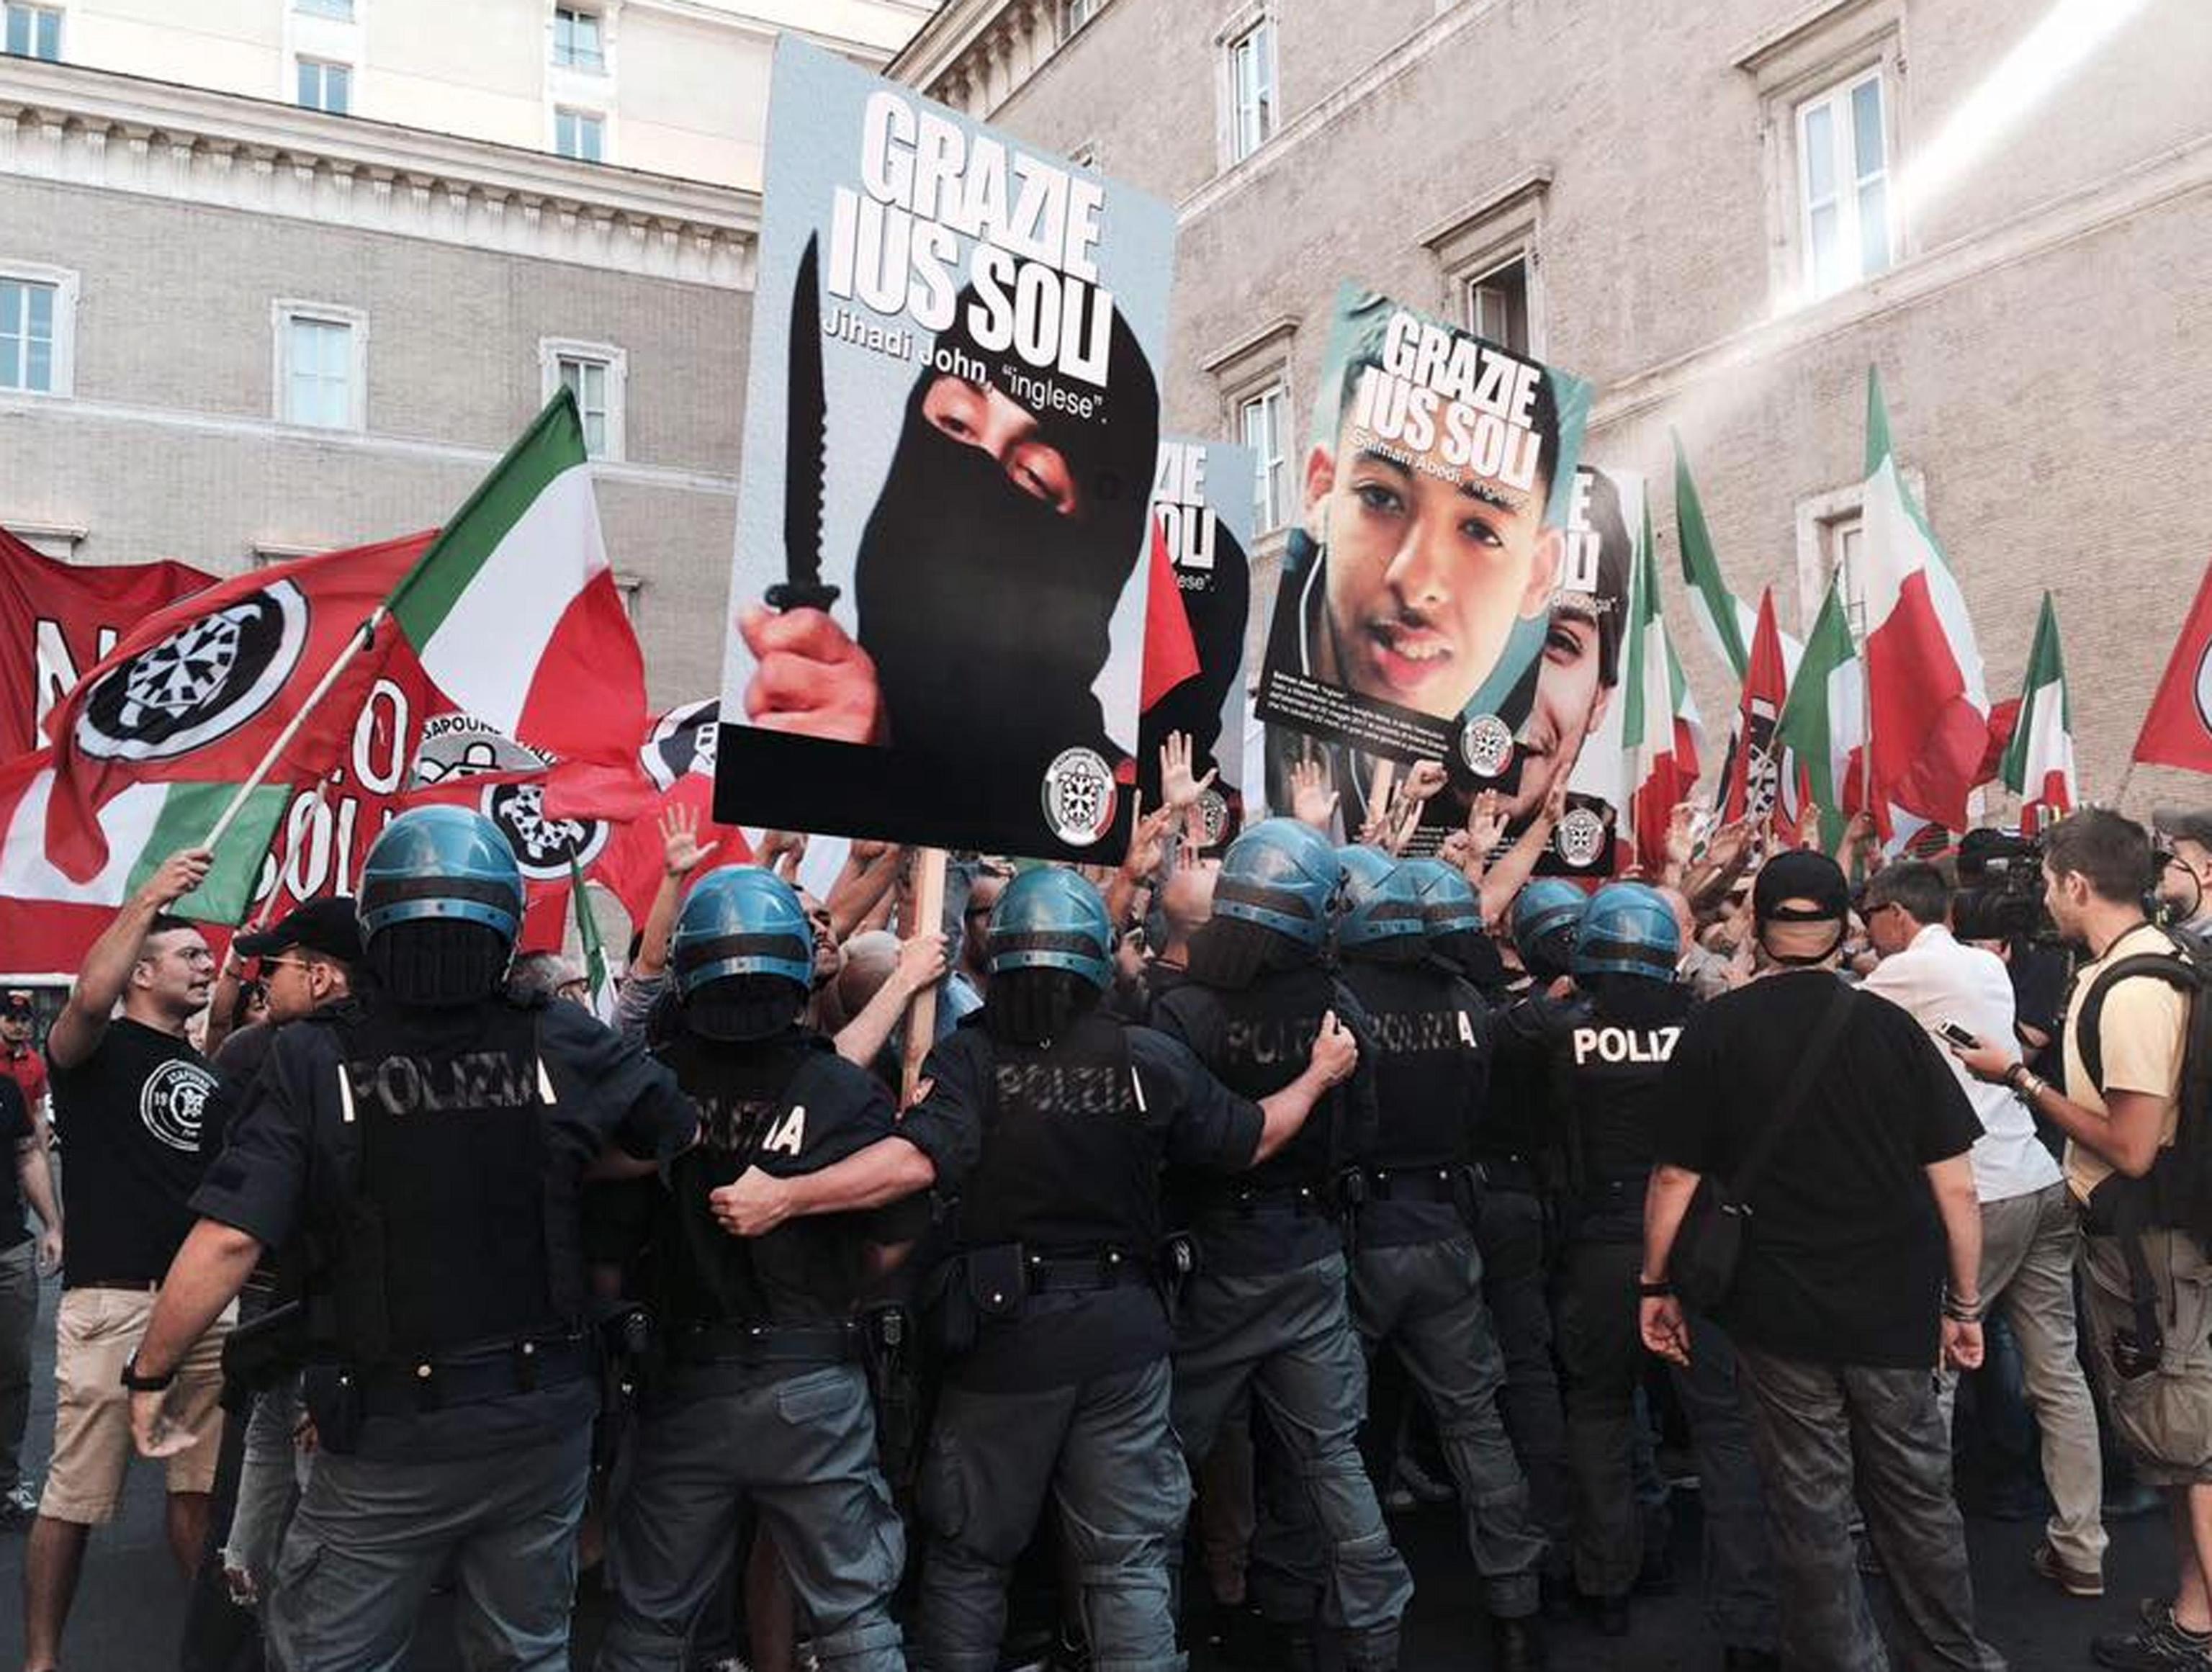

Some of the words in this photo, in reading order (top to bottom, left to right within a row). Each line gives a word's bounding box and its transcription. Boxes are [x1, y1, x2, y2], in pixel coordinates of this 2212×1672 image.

[862, 91, 1104, 287] GRAZIE
[828, 185, 959, 332] IUS
[967, 243, 1114, 387] SOLI
[823, 308, 913, 361] Jihadi
[919, 343, 994, 395] John,
[1382, 310, 1541, 428] GRAZIE
[1154, 441, 1208, 507] ZIE
[1356, 365, 1439, 453] IUS
[1441, 402, 1542, 493] SOLI
[1154, 504, 1215, 568] OLI
[1573, 1026, 1684, 1066] POLIZ
